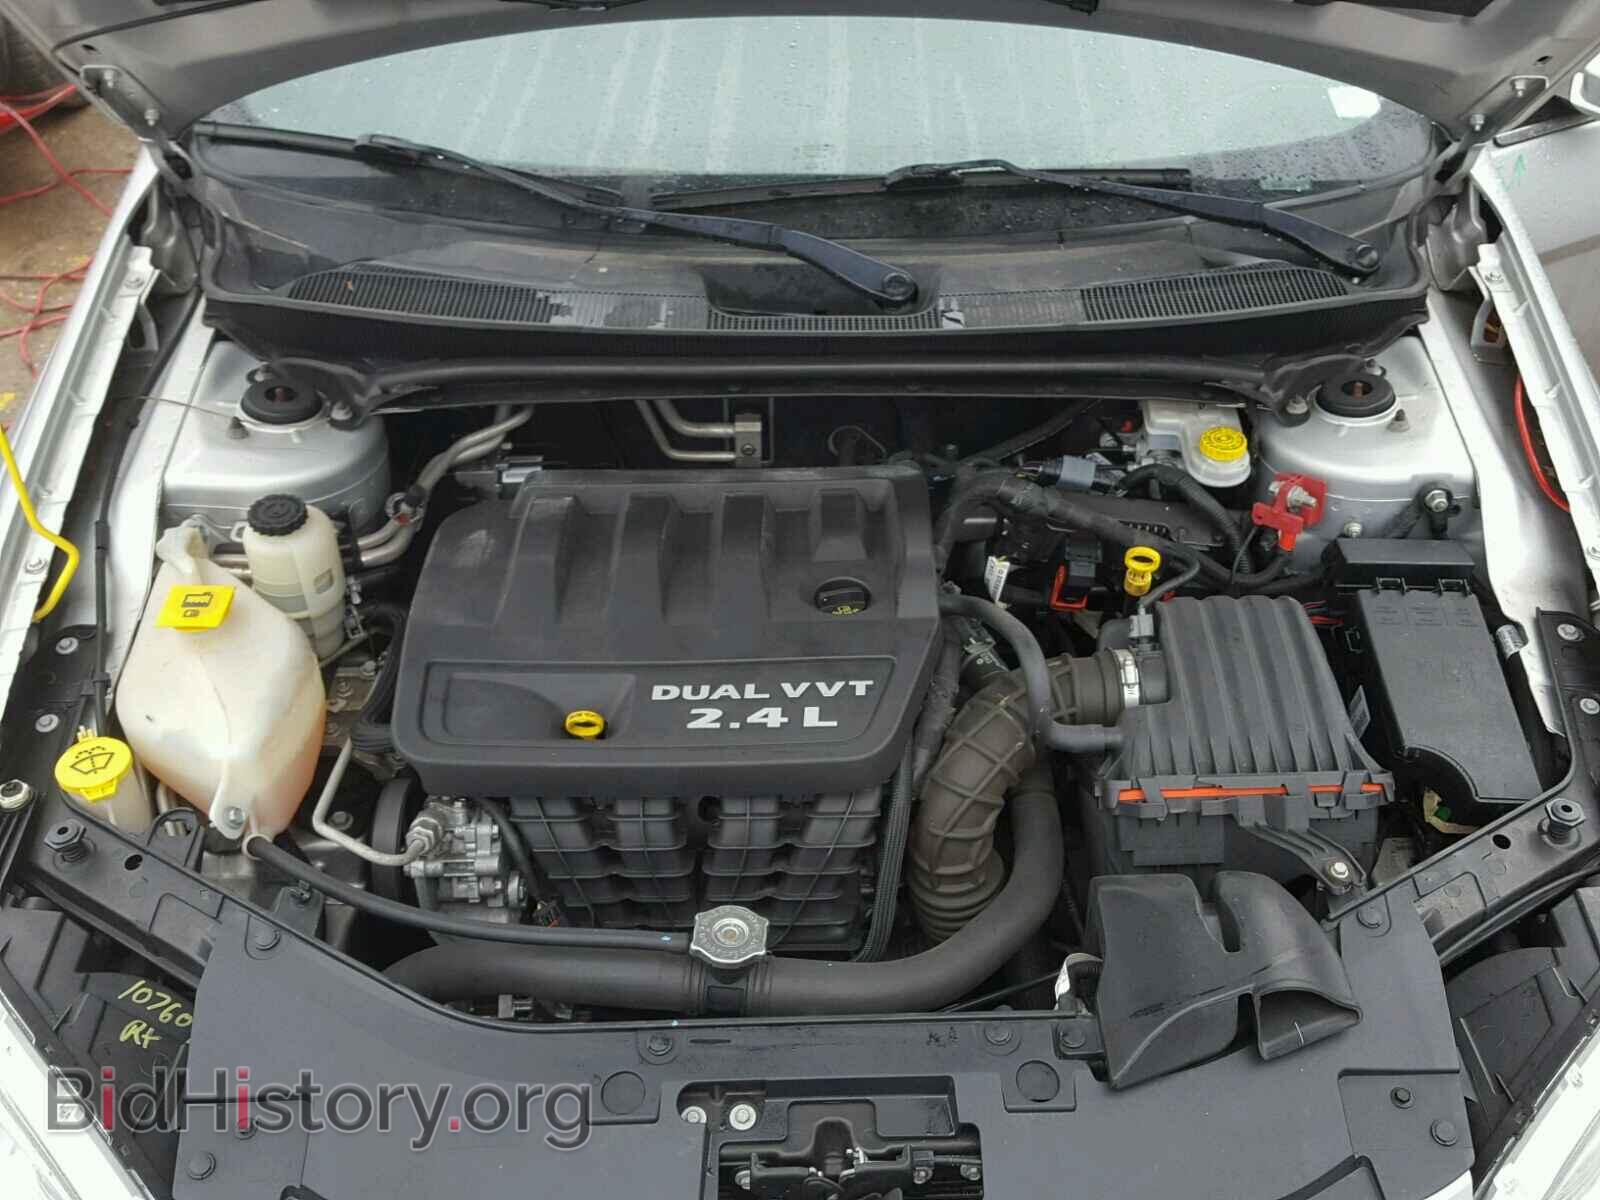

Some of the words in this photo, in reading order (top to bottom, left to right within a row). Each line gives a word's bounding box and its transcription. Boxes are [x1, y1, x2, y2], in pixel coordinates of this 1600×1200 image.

[651, 684, 771, 701] DUAL
[780, 680, 875, 698] VVT
[117, 979, 193, 1027] 10760
